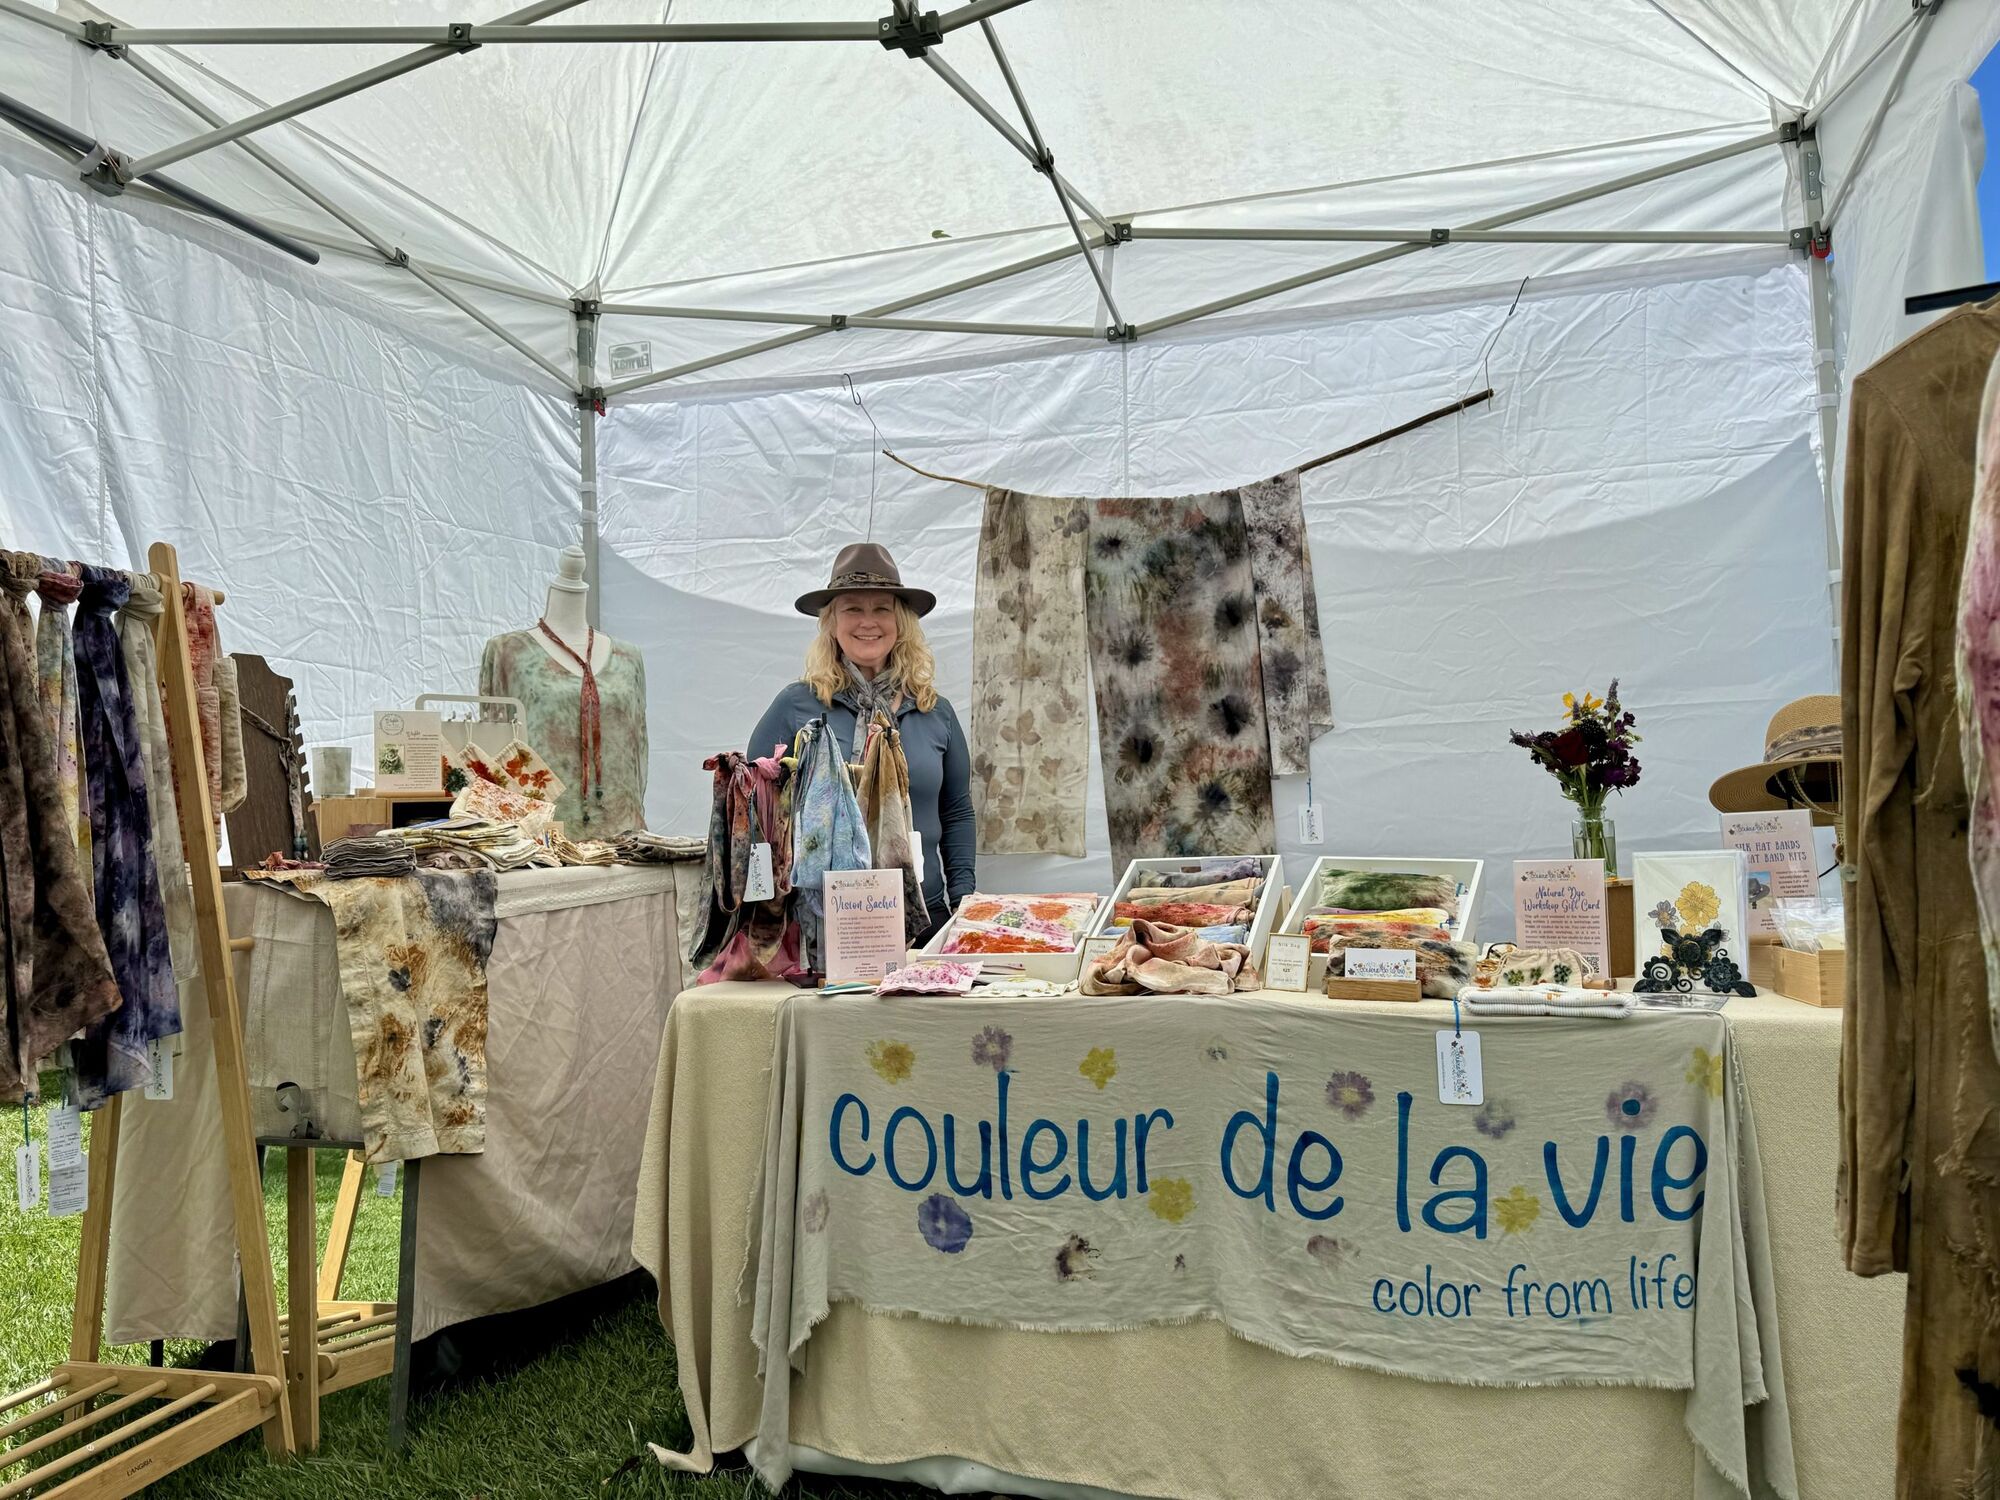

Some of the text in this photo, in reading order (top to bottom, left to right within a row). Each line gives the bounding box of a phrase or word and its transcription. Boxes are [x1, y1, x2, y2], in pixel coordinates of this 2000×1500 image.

[1755, 841, 1772, 852] HAT
[1775, 839, 1801, 850] BANDS
[1764, 852, 1785, 863] BAND
[1788, 851, 1808, 862] KITS
[1535, 885, 1585, 900] Natural Dye
[830, 894, 898, 914] Vision Sachet
[1523, 898, 1600, 913] Workshop Gift Card
[828, 1071, 1707, 1241] couleur de la vie
[1372, 1253, 1694, 1319] color from life
[126, 1458, 153, 1477] LANGRIA
